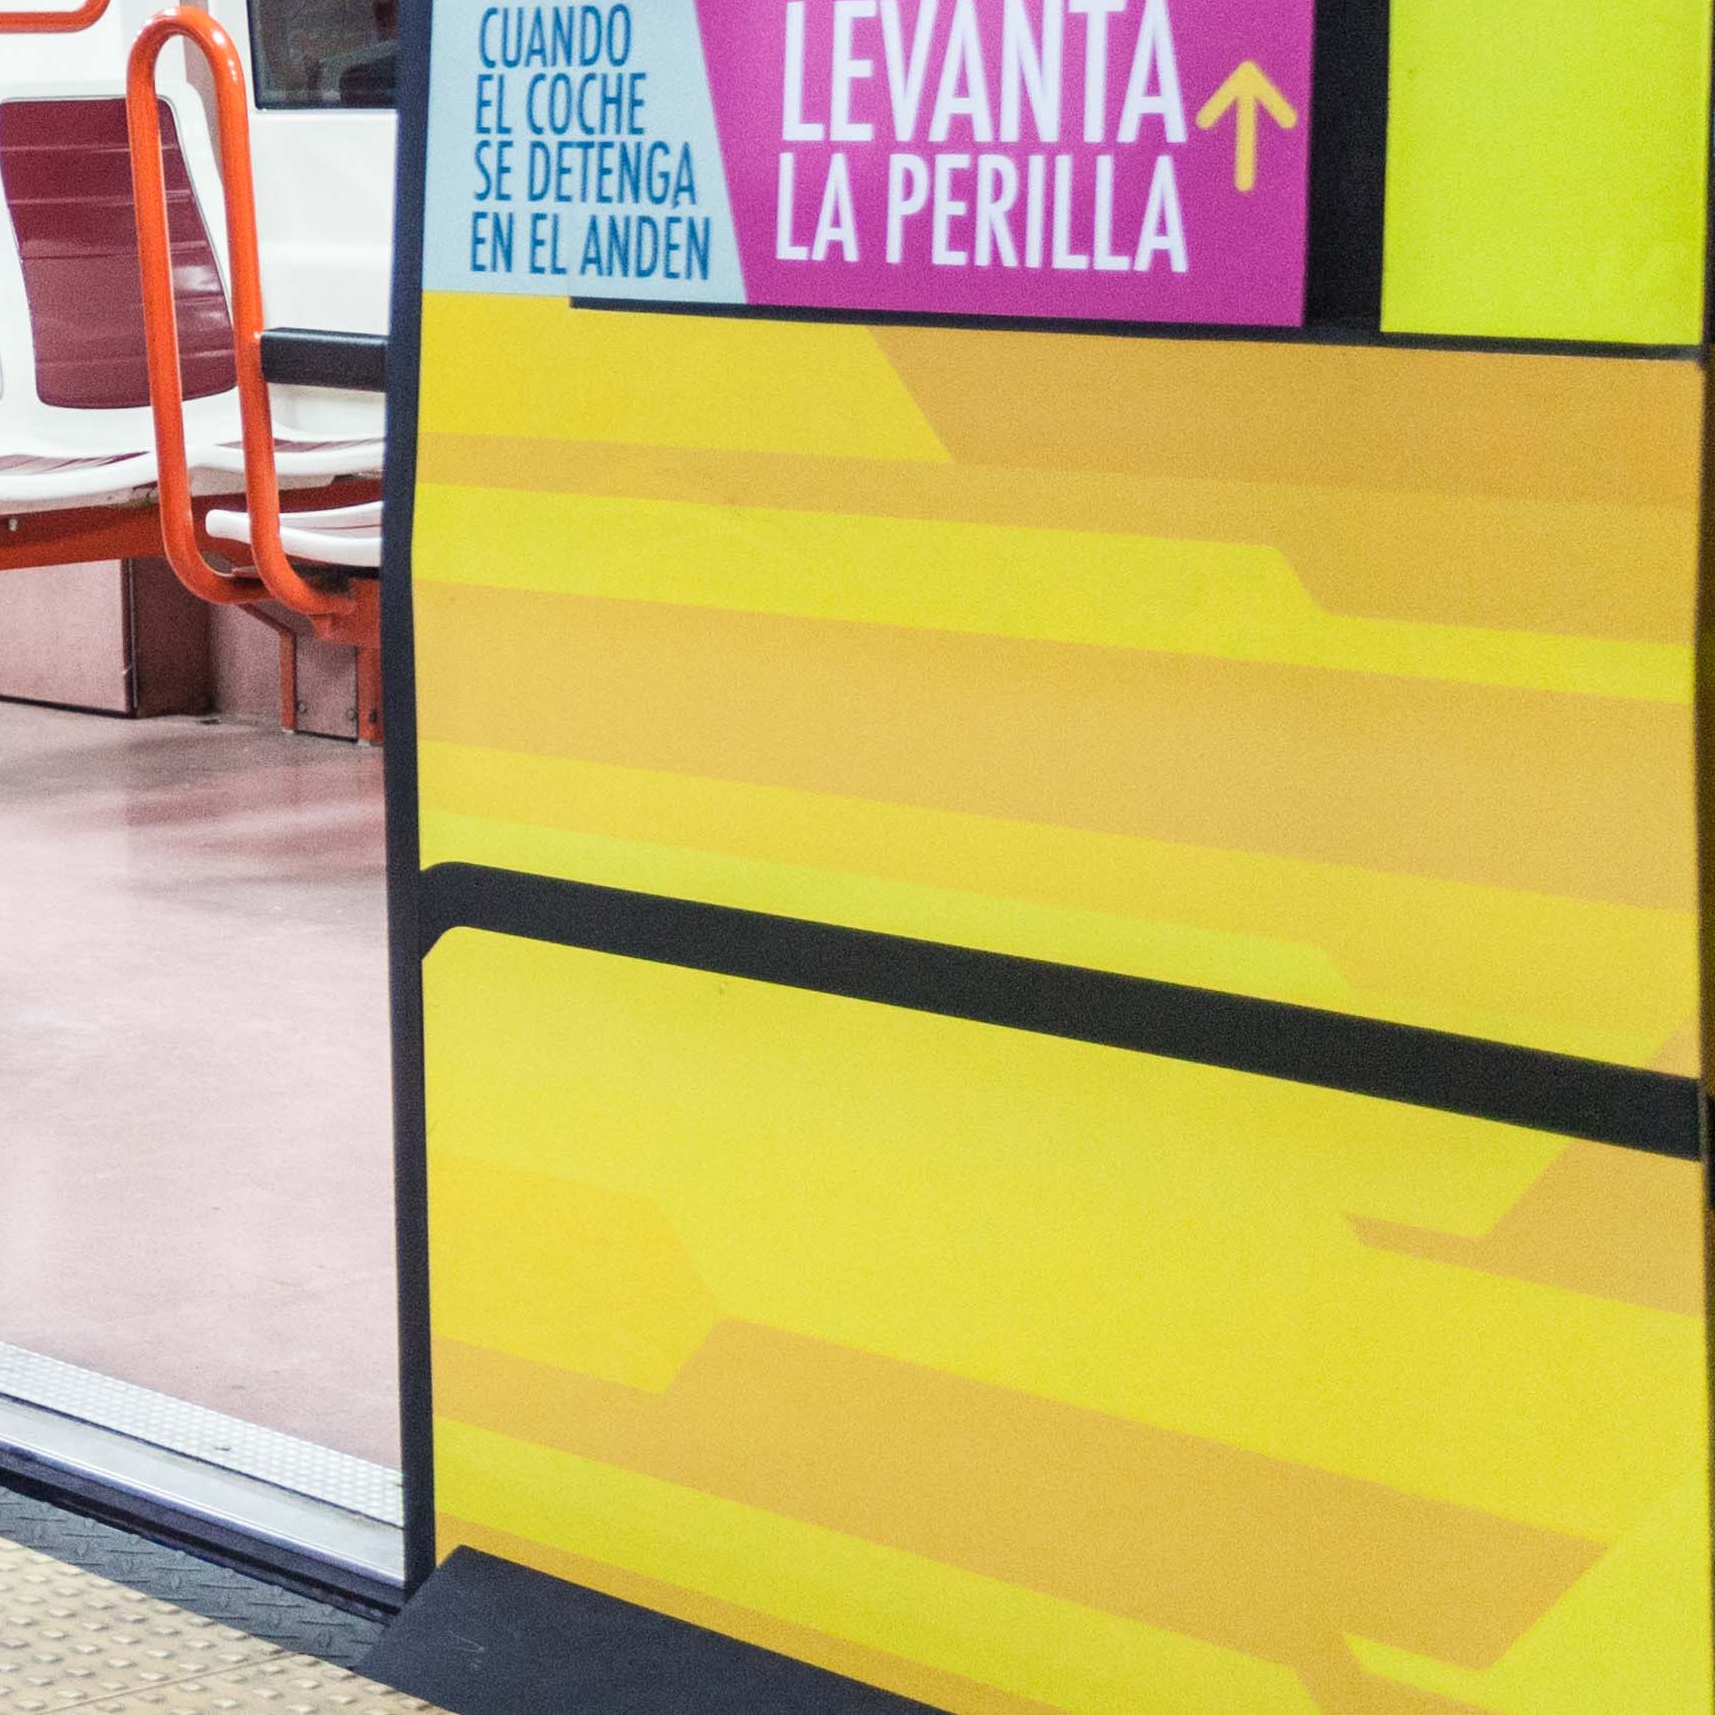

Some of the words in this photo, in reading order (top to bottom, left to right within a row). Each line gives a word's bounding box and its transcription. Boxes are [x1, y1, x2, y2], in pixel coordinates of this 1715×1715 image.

[478, 3, 632, 68] CUANDO
[475, 74, 513, 134] EL
[526, 72, 647, 135] COCHE
[474, 140, 513, 201] SE
[527, 141, 697, 206] DETENGA
[471, 211, 514, 273] EN
[528, 213, 568, 275] EL
[776, 152, 859, 263] LA
[886, 153, 1188, 273] PERILLA
